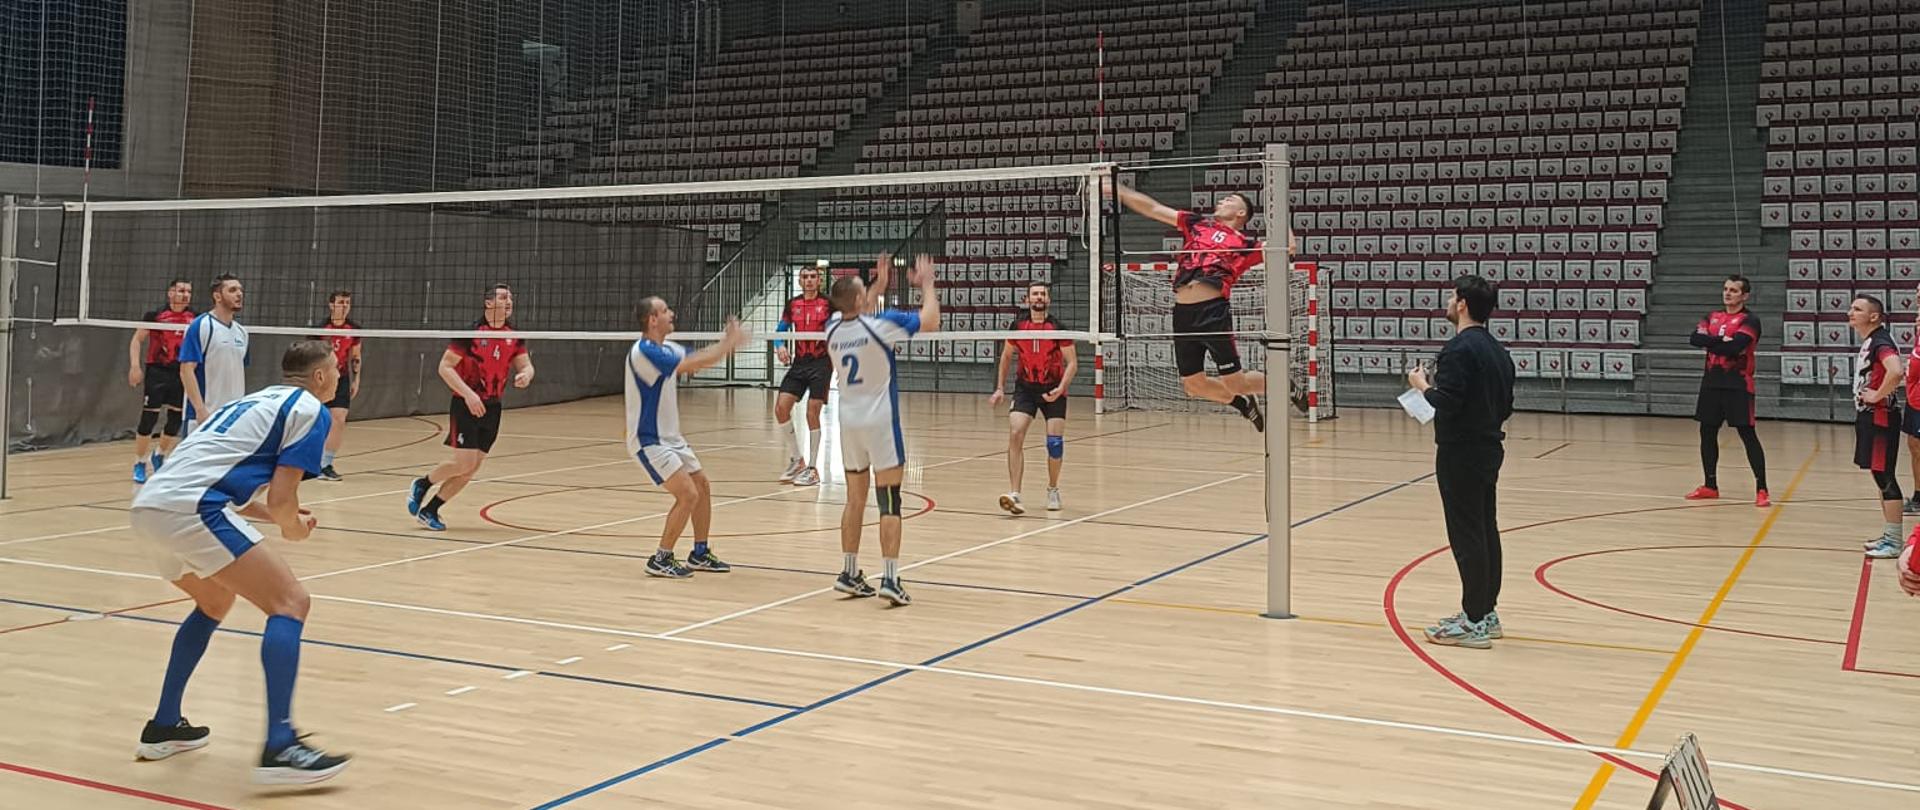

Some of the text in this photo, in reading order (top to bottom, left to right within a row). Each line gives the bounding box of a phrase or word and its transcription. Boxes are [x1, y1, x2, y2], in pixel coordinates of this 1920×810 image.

[1211, 230, 1228, 243] 15
[492, 345, 500, 360] 4
[842, 353, 864, 385] 2
